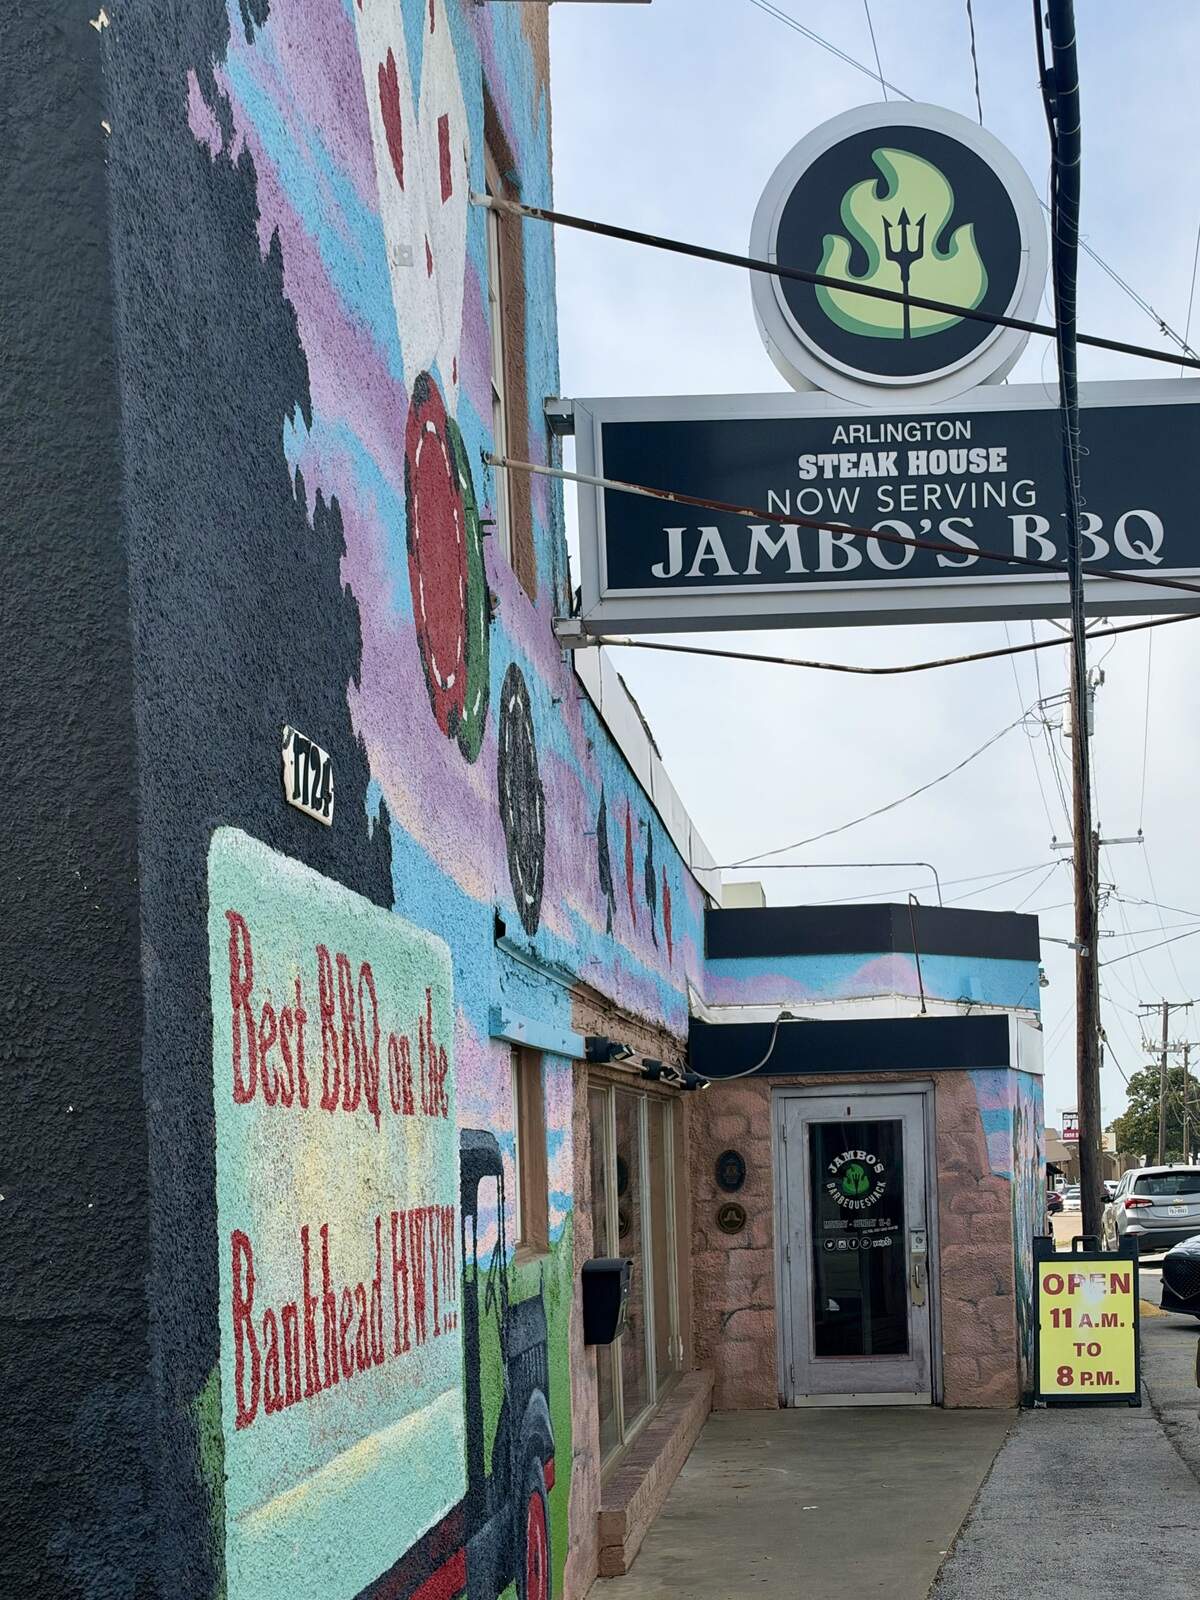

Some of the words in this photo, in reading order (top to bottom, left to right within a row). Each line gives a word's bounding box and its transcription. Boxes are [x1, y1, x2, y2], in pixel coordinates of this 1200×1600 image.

[832, 420, 971, 444] ARLINGTON
[798, 451, 898, 480] STEAK
[908, 447, 1007, 475] HOUSE
[767, 487, 860, 515] NOW
[877, 479, 1036, 512] SERVING
[651, 516, 980, 578] JAMBO'S
[1007, 509, 1164, 565] BBQ
[293, 733, 332, 817] 1724
[225, 908, 309, 1109] Best
[316, 944, 381, 1132] BBQ
[388, 1033, 414, 1115] on
[418, 987, 449, 1119] the
[828, 1150, 885, 1174] JAMBO'S
[1043, 1273, 1130, 1295] OPEN
[230, 1215, 385, 1431] Bankhead
[1050, 1308, 1072, 1328] 11
[1079, 1313, 1125, 1328] A.M.
[1073, 1342, 1101, 1357] TO
[1056, 1365, 1074, 1386] 8
[1080, 1371, 1120, 1386] P.M.
